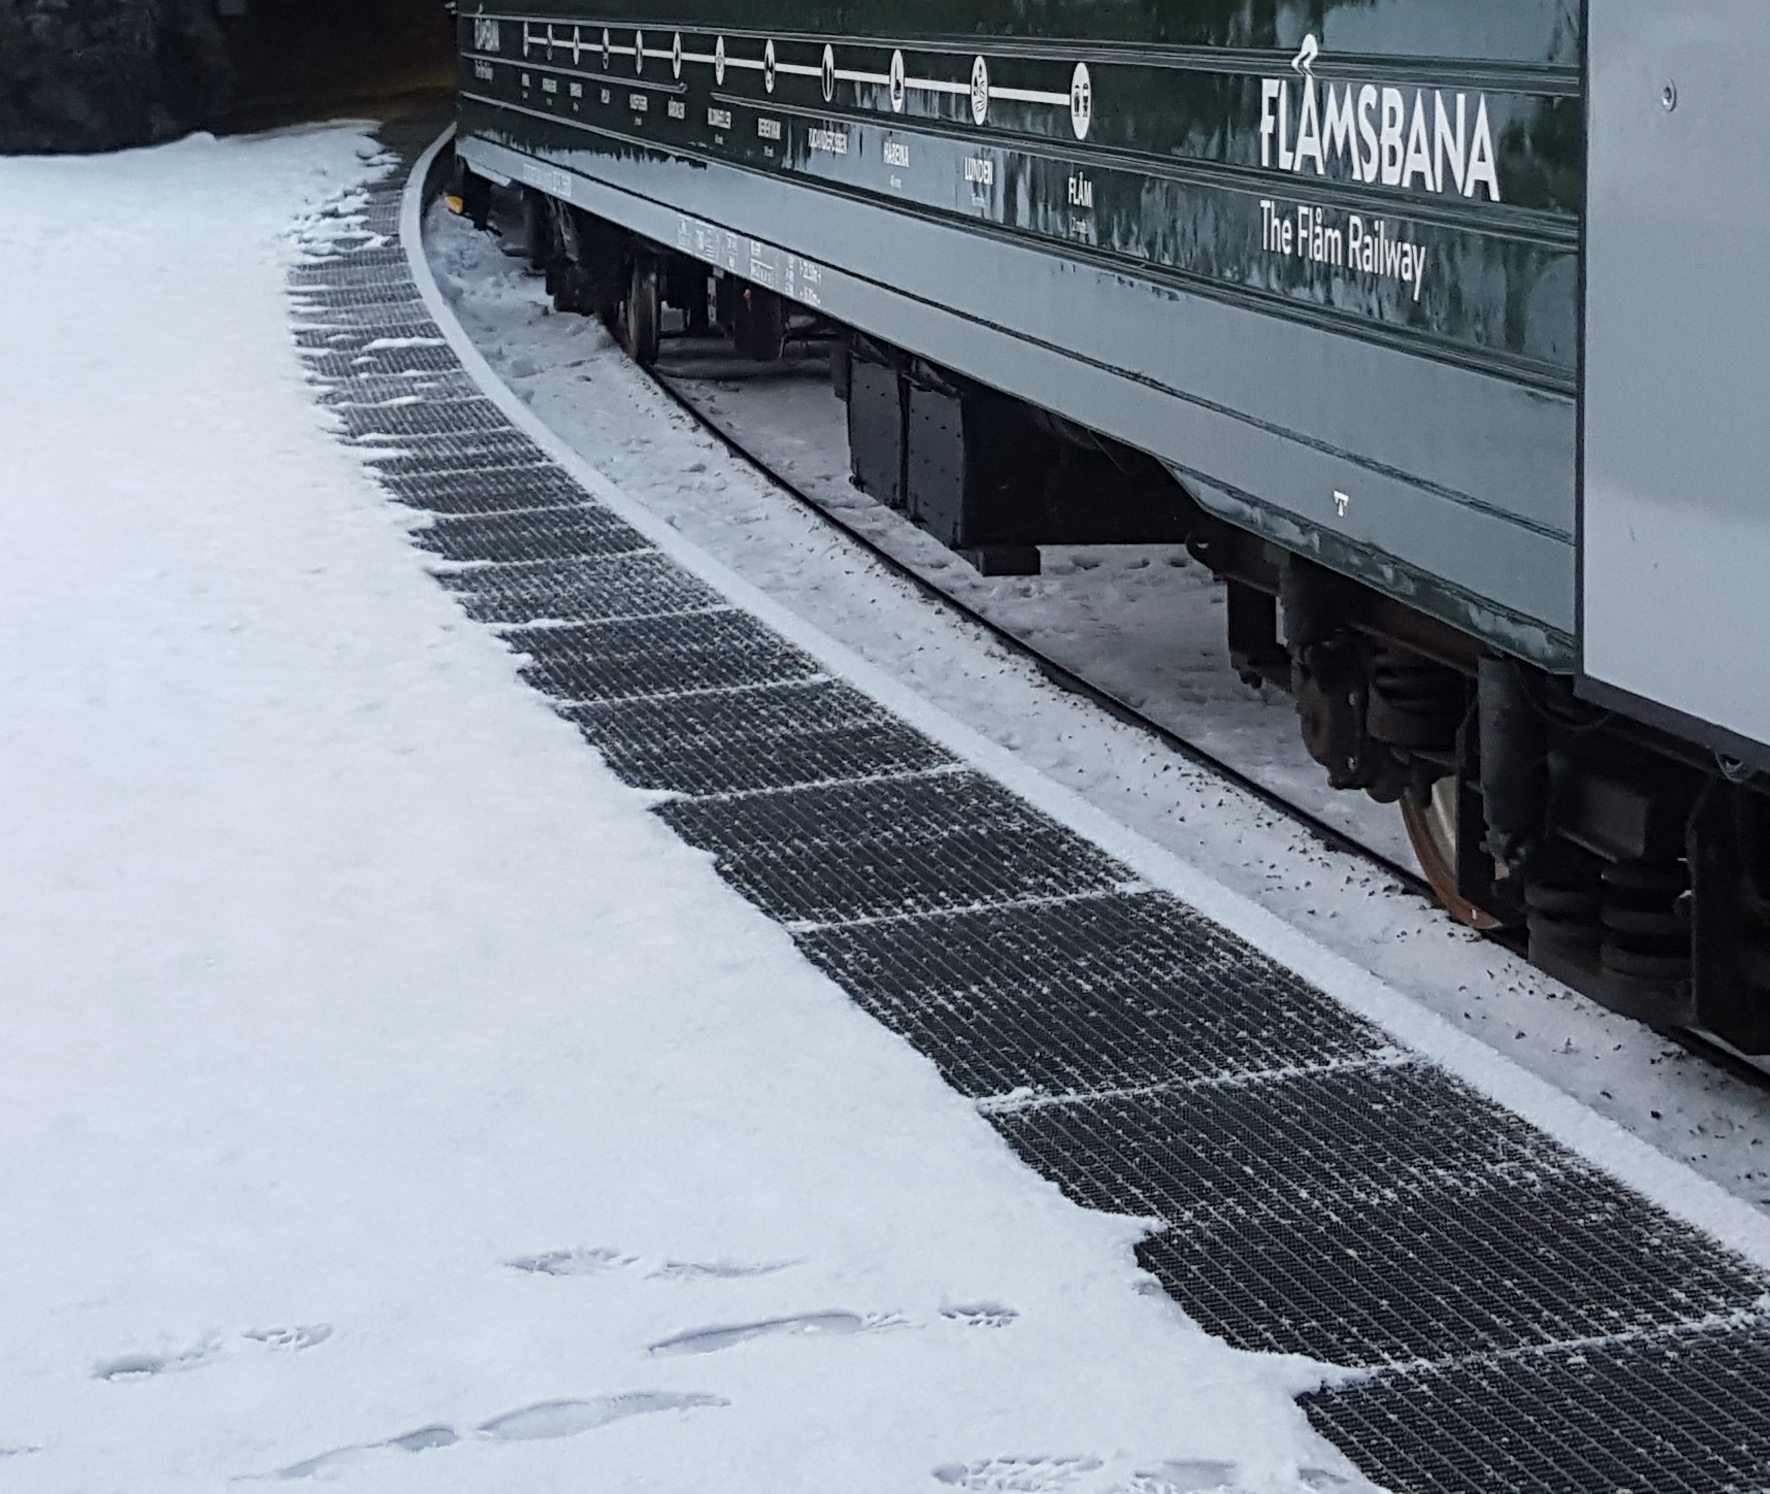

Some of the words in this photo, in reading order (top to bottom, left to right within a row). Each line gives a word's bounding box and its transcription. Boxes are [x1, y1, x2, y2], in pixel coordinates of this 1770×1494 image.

[1259, 68, 1500, 202] FLÅMSBANA
[964, 156, 993, 185] LUNDEN
[1068, 171, 1093, 208] FLÅM
[1260, 200, 1292, 255] The
[1297, 207, 1342, 267] Flåm
[1348, 216, 1426, 301] Railway
